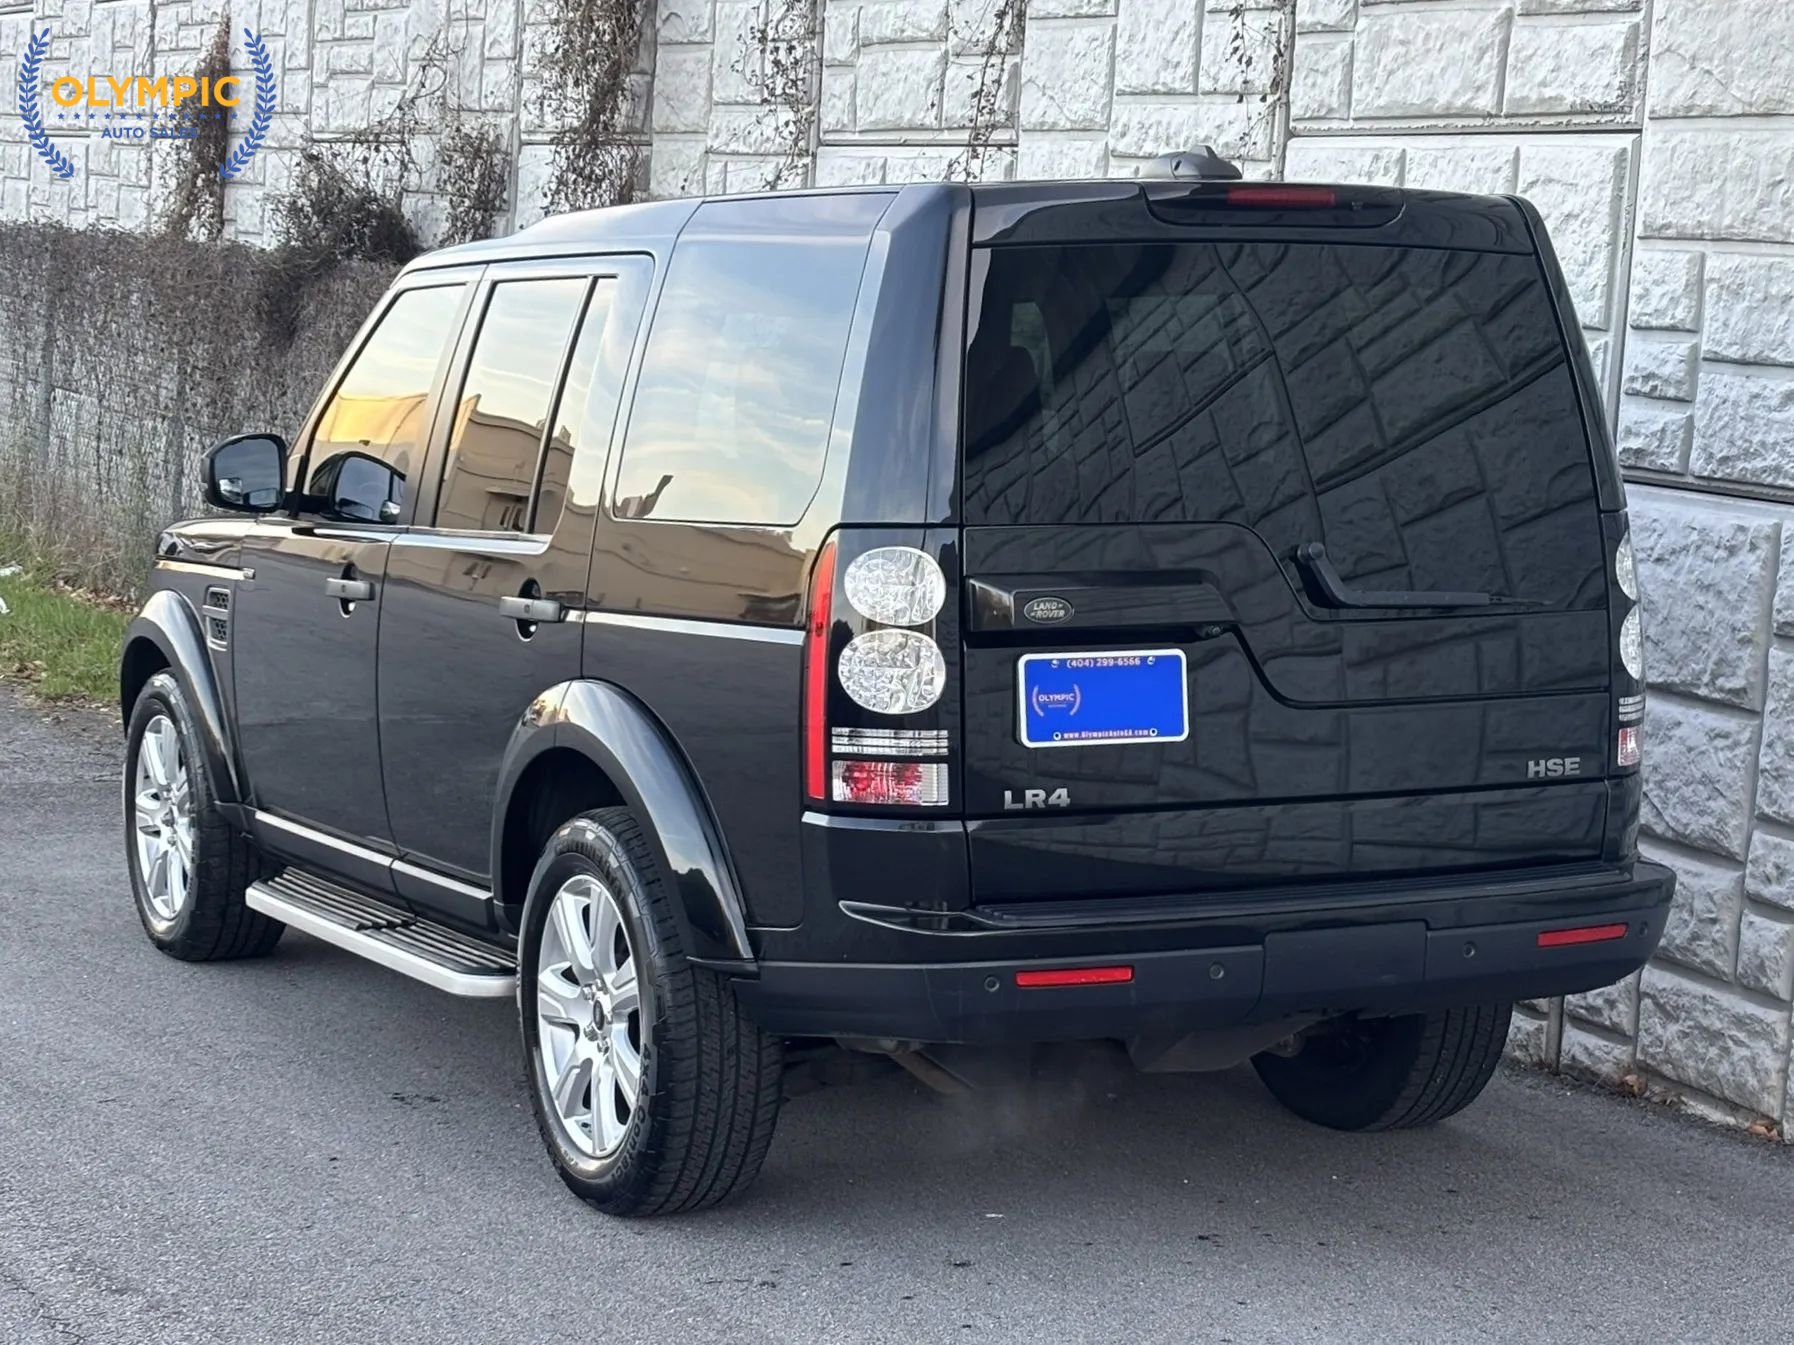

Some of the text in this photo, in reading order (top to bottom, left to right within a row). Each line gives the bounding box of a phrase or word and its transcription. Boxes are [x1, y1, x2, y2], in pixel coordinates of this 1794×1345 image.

[1033, 601, 1058, 610] LAND
[1066, 658, 1094, 668] (404)
[1038, 693, 1075, 702] OLYMPIC
[1528, 757, 1580, 779] HSE
[1004, 788, 1071, 810] LR4
